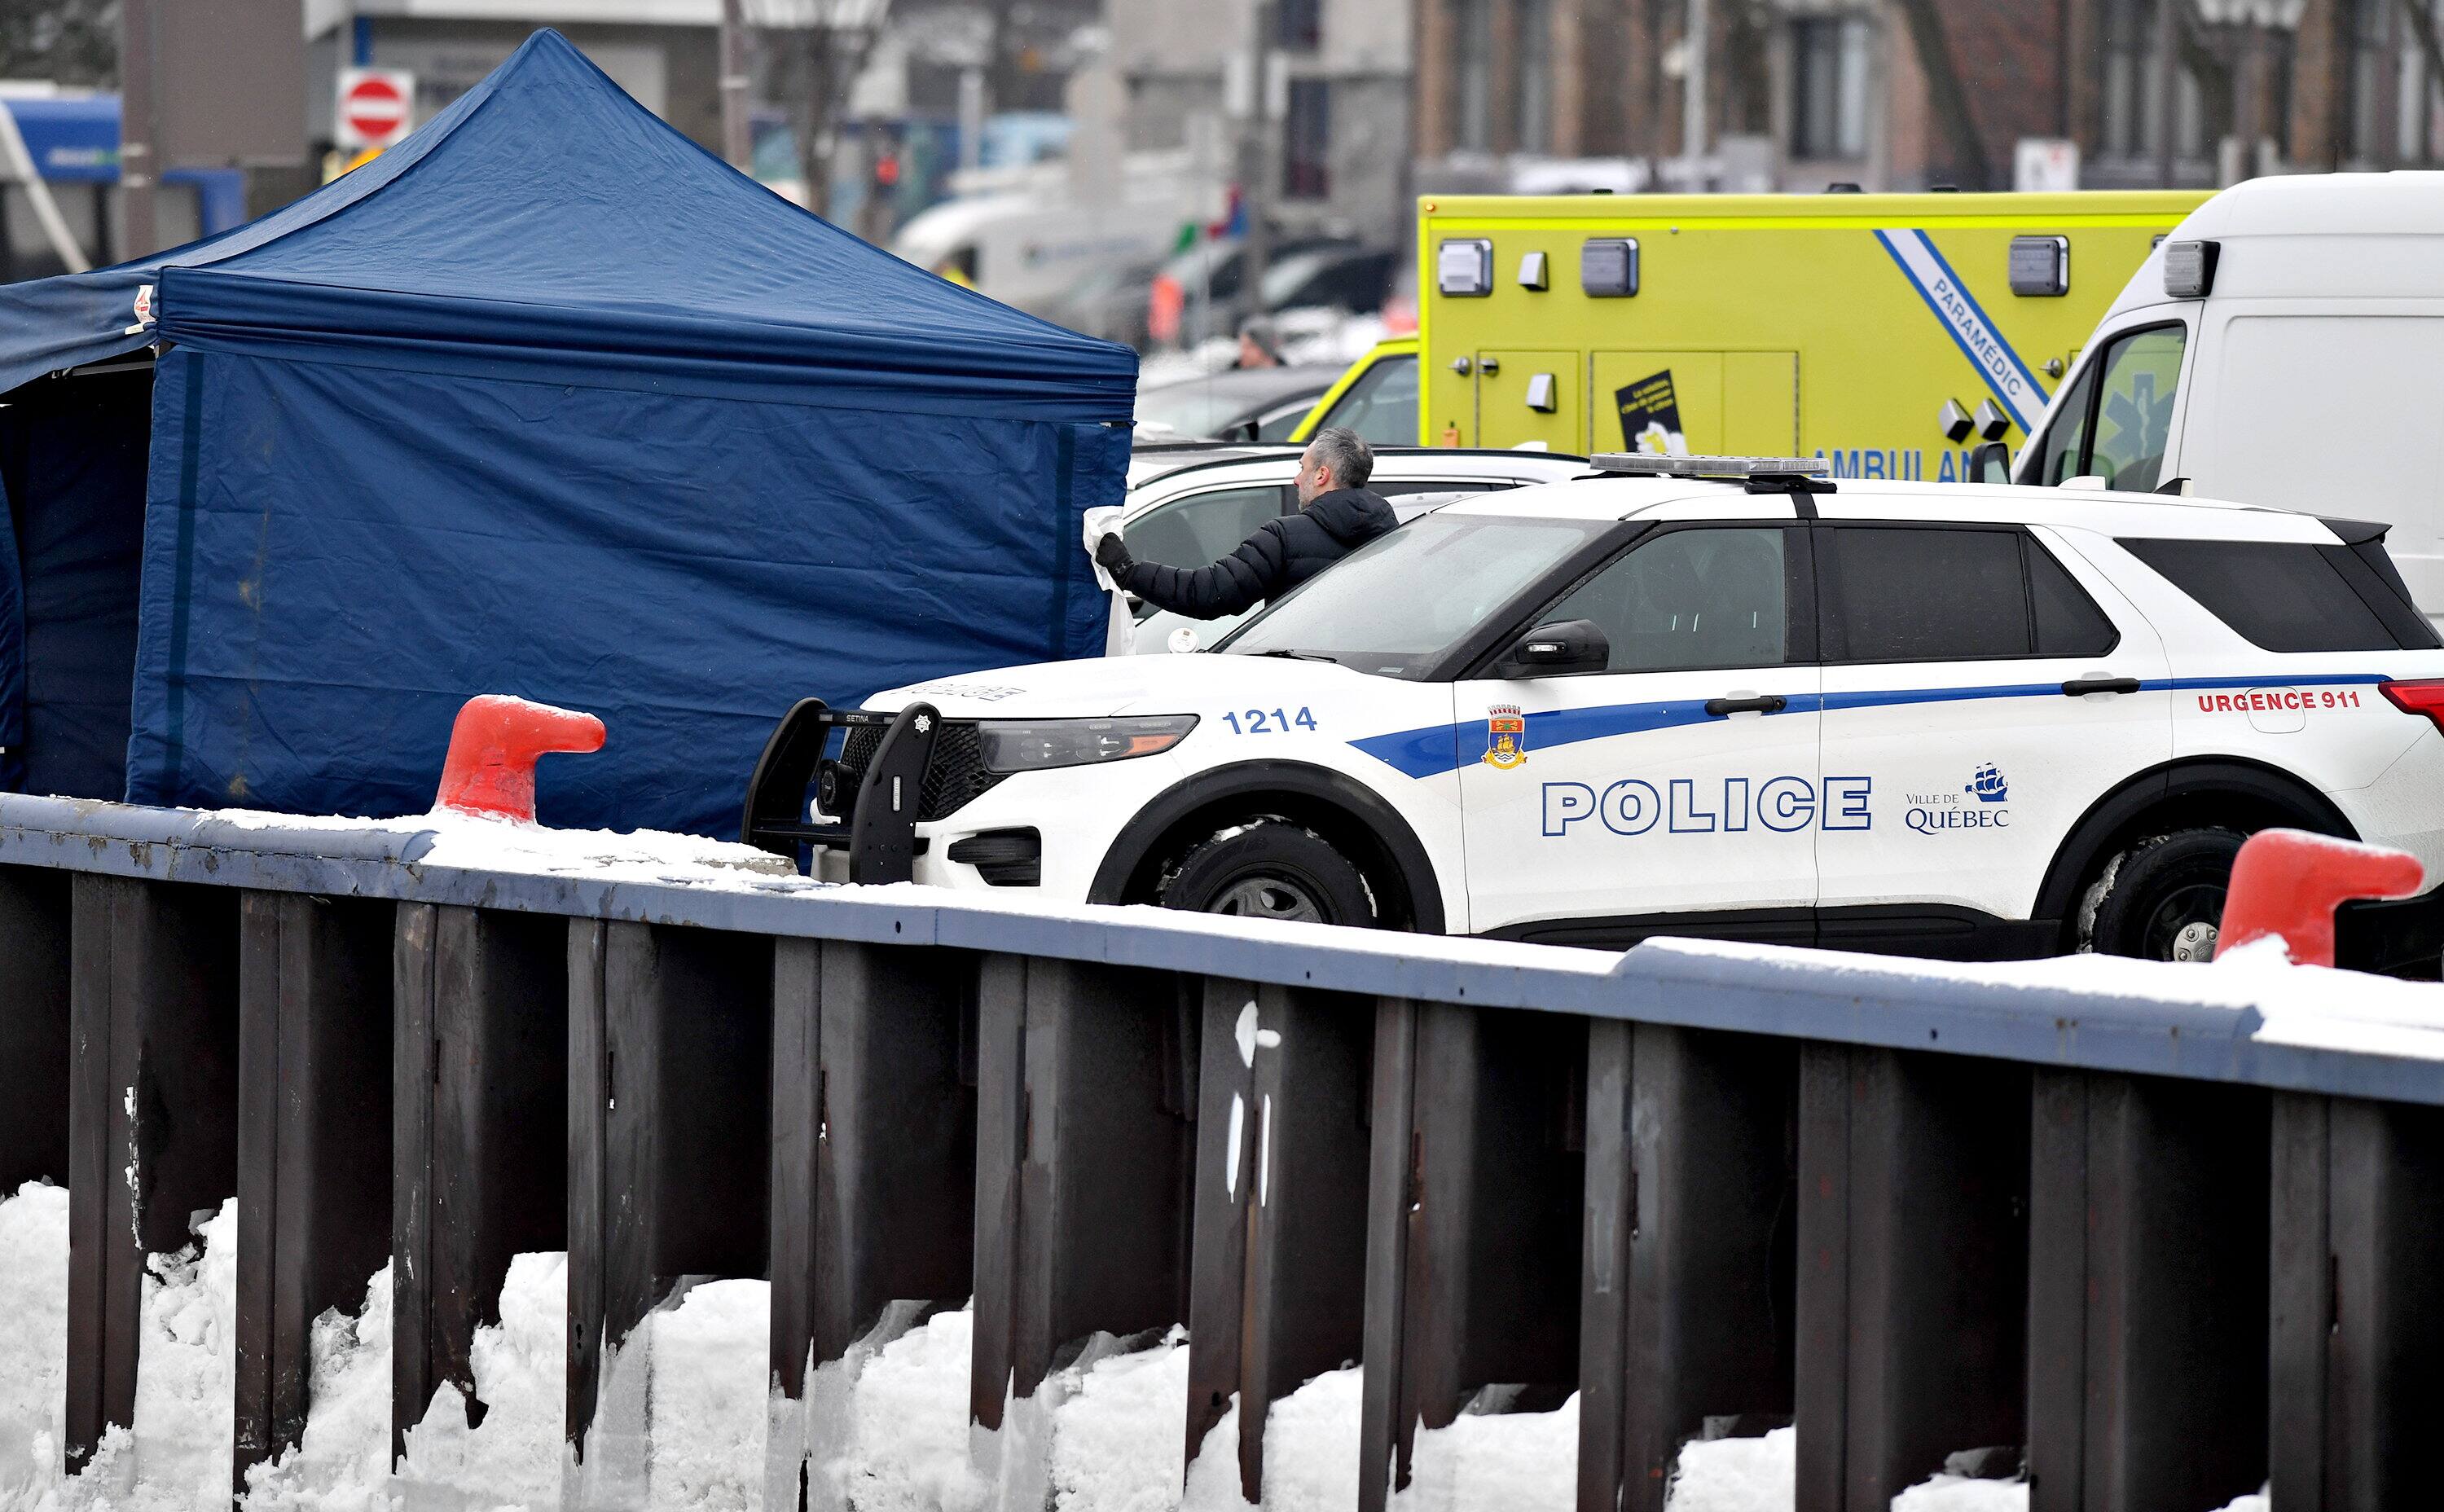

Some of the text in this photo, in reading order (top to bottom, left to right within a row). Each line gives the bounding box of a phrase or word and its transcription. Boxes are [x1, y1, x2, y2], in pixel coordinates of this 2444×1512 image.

[1933, 279, 2020, 396] PARAMÉDIC
[1810, 450, 2020, 483] AMBULAN
[2198, 691, 2360, 713] URGENCE 911
[846, 714, 869, 723] SETINA
[1222, 706, 1317, 735] 1214
[1542, 776, 1871, 837] POLICE
[1905, 806, 2010, 836] QUÉBEC
